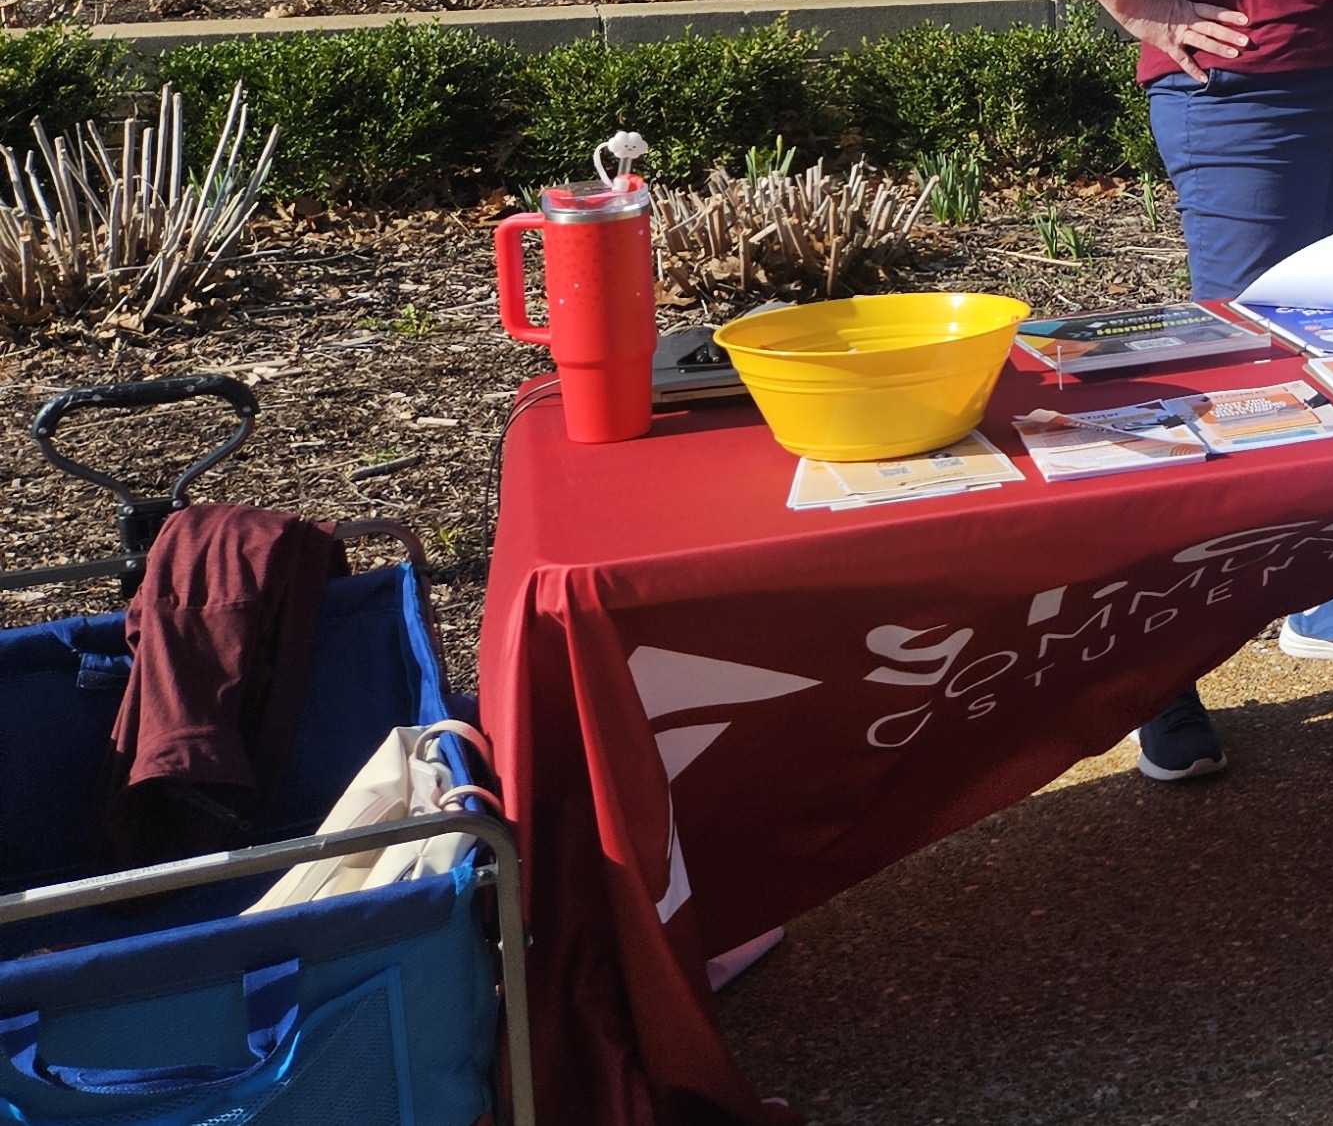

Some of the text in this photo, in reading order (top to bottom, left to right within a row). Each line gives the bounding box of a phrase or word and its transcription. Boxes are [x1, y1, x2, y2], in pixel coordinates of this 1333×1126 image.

[1097, 316, 1214, 335] Handshake
[67, 860, 189, 889] CAREER SERVICES
